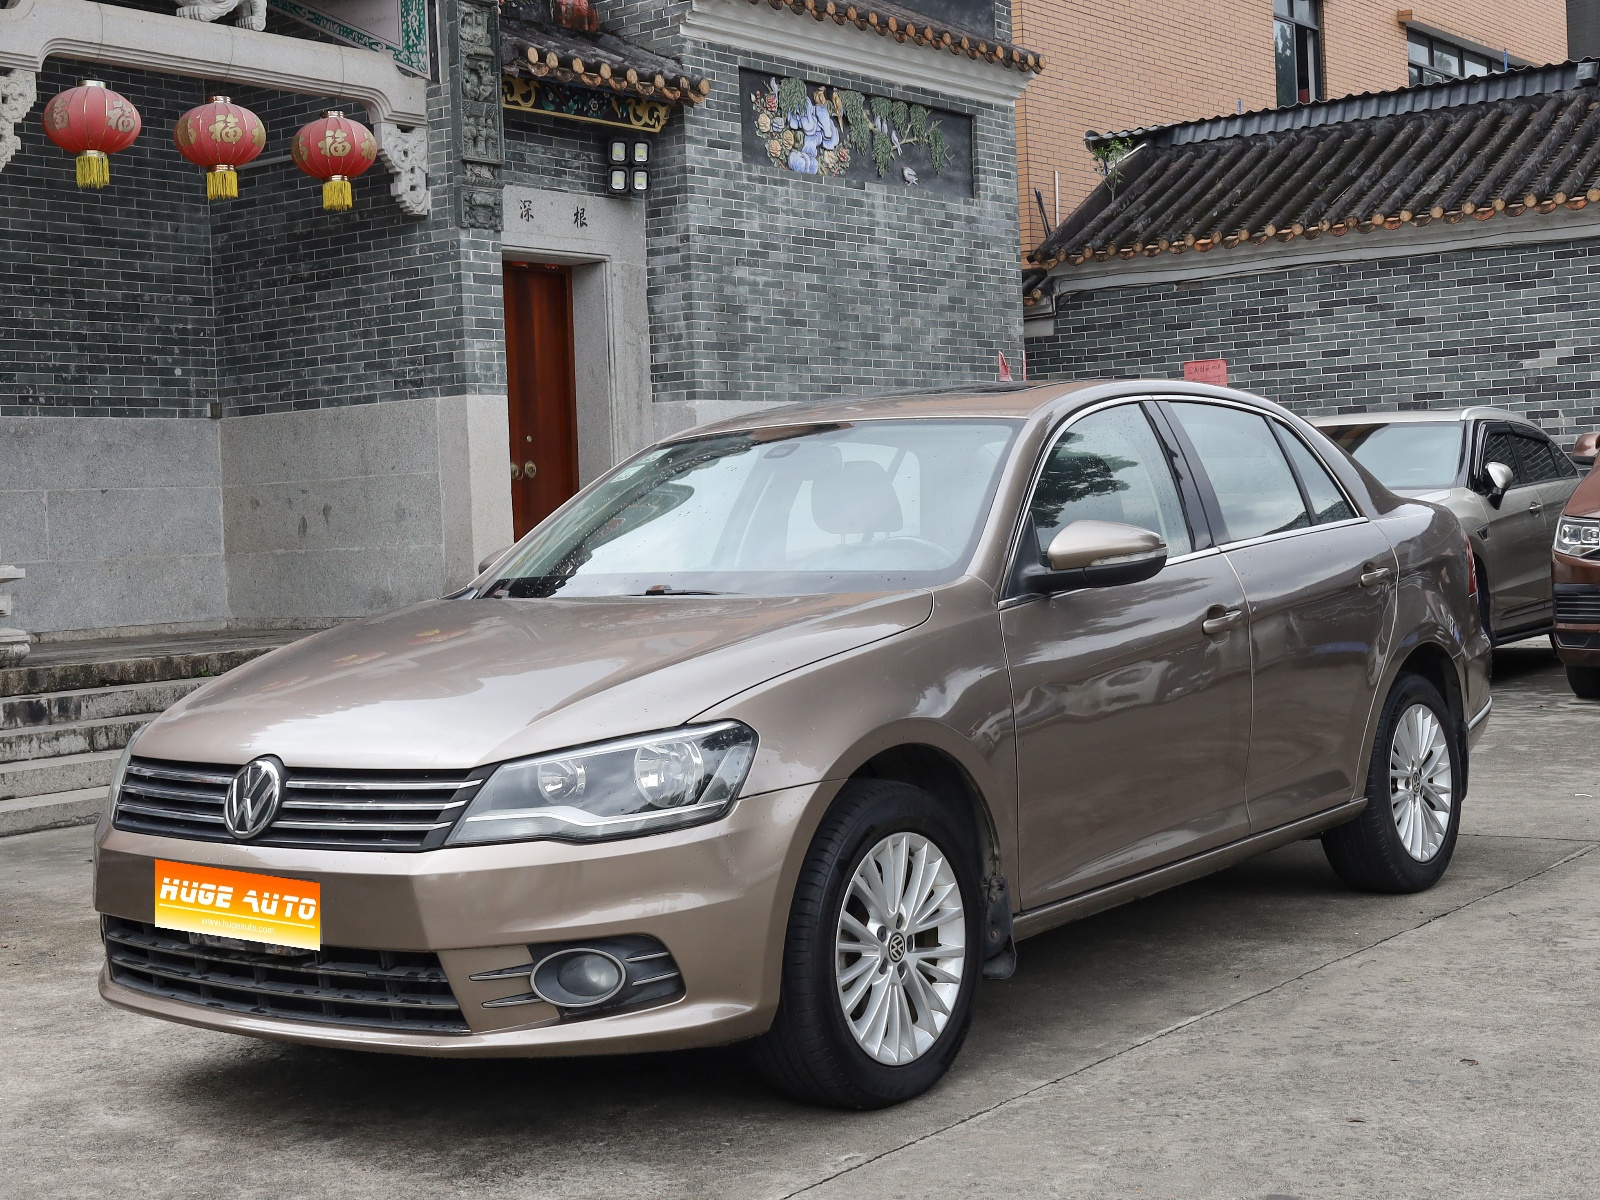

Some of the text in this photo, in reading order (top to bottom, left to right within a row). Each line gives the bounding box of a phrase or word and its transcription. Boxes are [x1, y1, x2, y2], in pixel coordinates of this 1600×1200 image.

[107, 100, 135, 133] 福
[208, 113, 243, 143] 福
[317, 128, 352, 158] 福
